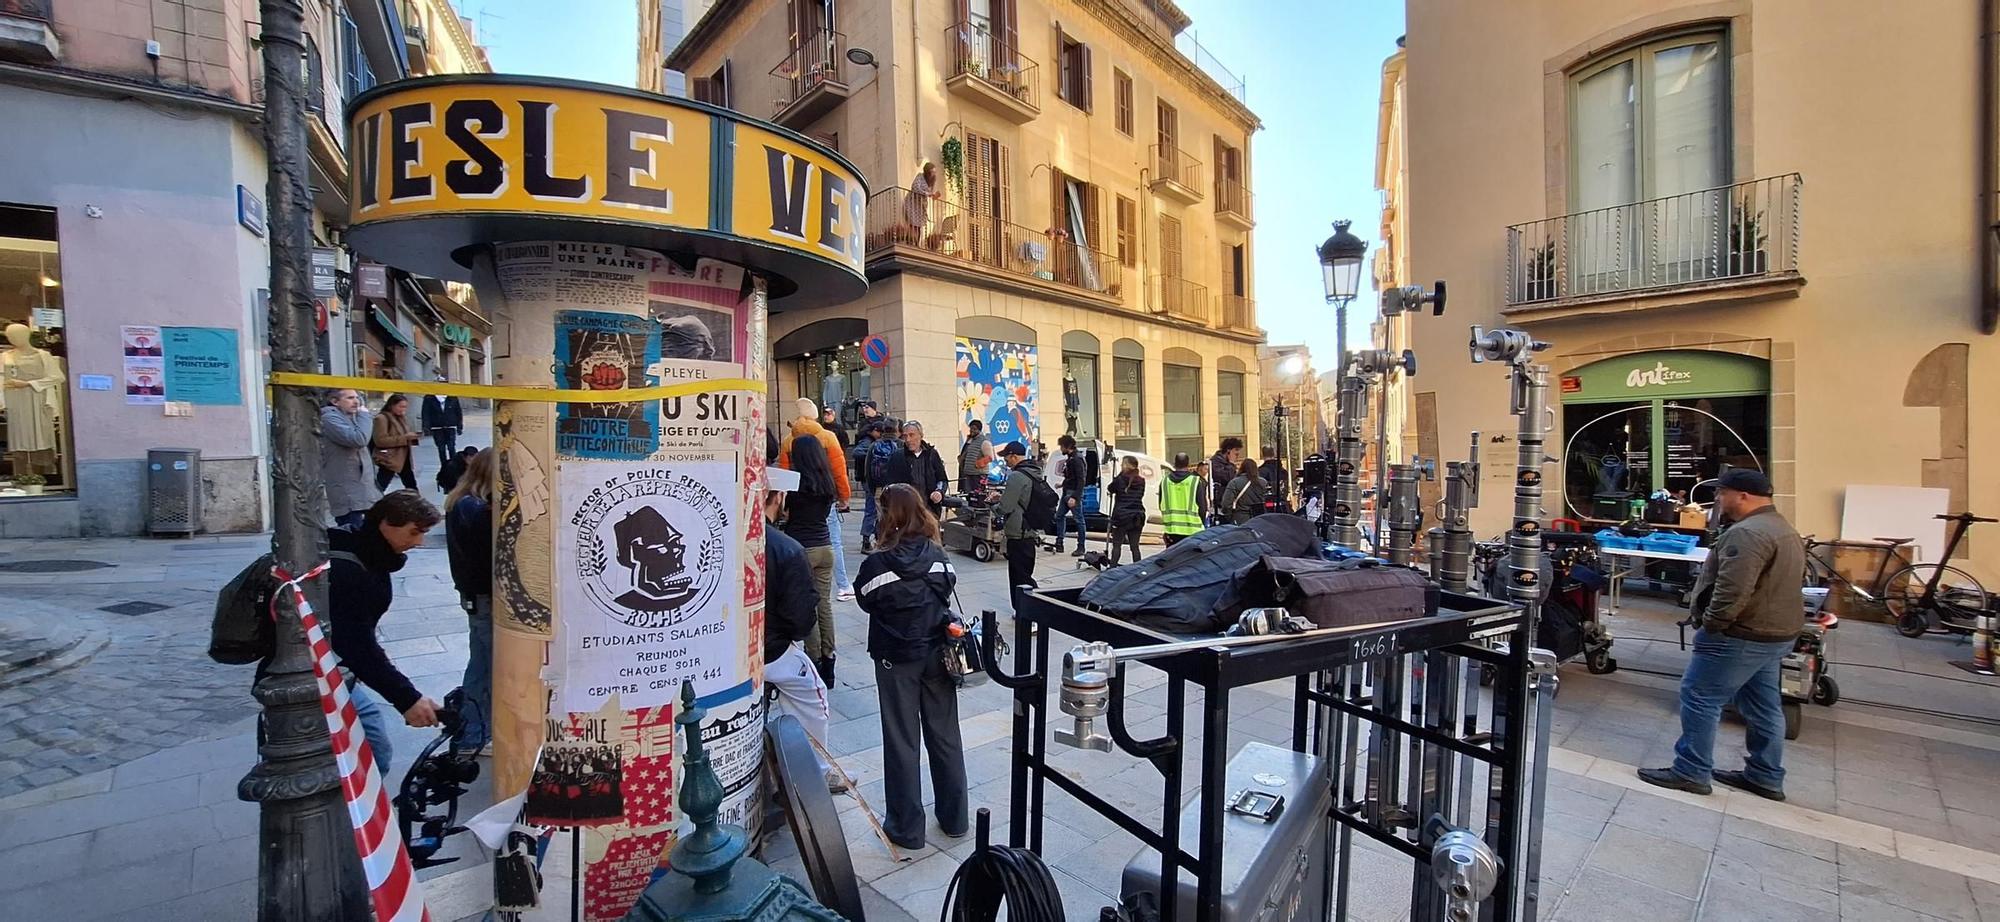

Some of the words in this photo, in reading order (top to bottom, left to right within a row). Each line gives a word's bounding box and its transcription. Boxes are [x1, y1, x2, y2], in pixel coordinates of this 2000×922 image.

[357, 100, 674, 213] VESLE
[558, 243, 613, 255] MILLE
[558, 254, 585, 263] UNE
[597, 256, 645, 270] MAINS
[651, 258, 724, 283] FERE
[174, 361, 230, 369] PRINTEMPS
[664, 367, 708, 379] PLEYEL
[662, 395, 681, 420] U
[696, 393, 737, 420] SKI
[581, 419, 628, 436] NOTRE
[658, 426, 683, 436] EIGE
[687, 427, 698, 436] ET
[571, 488, 602, 526] RECTOR
[605, 477, 618, 489] OF
[627, 468, 671, 481] POLICE
[680, 475, 729, 528] REPRESSION
[624, 608, 683, 628] ROCHE
[582, 632, 665, 649] ETUDIANTS
[671, 621, 726, 641] SALARIES
[636, 648, 687, 662] REUNION
[619, 664, 667, 677] CHAQUE
[676, 658, 701, 670] SOIR
[588, 684, 639, 696] CENTRE
[650, 674, 696, 690] CENSR
[703, 667, 722, 680] 441
[701, 726, 721, 740] au
[630, 849, 651, 859] DEUX
